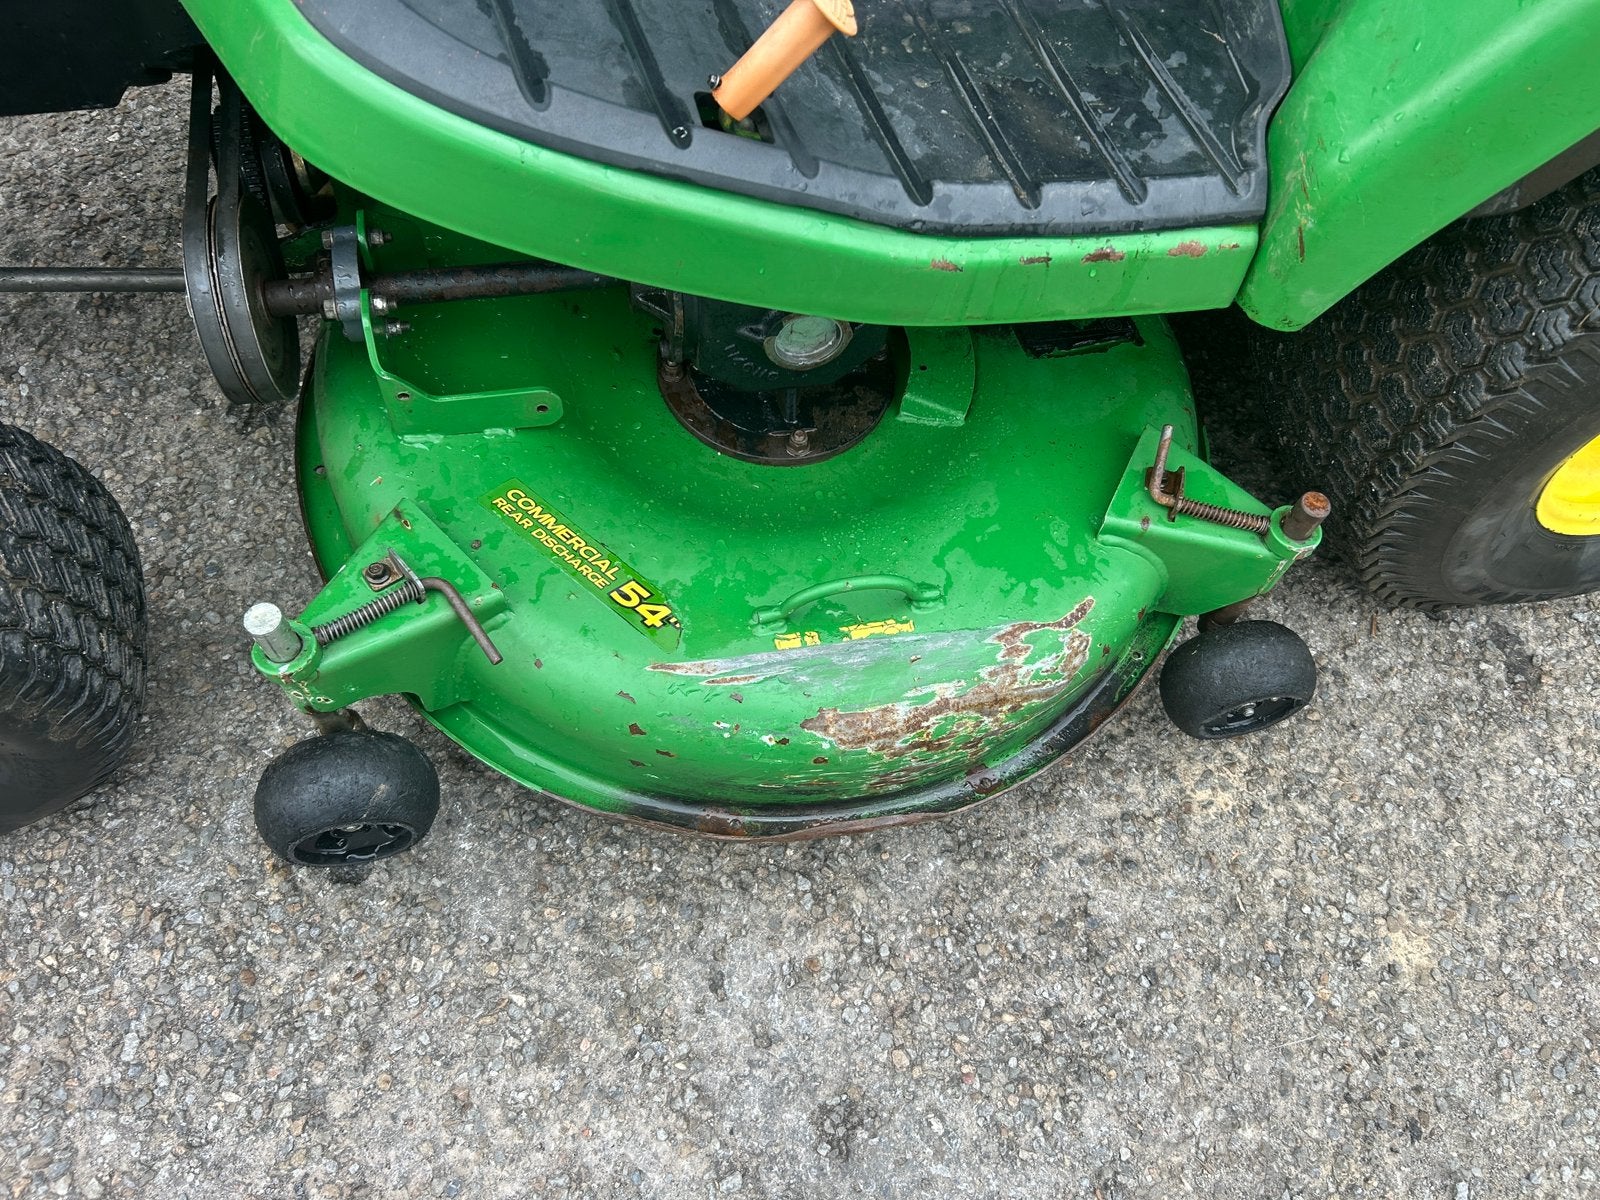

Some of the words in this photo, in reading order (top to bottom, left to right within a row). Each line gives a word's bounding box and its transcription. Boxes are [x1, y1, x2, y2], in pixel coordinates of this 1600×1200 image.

[492, 497, 534, 529] REAR
[531, 528, 610, 589] DISCHARGE
[506, 489, 620, 581] COMMERCIAL
[608, 579, 681, 628] 54"
